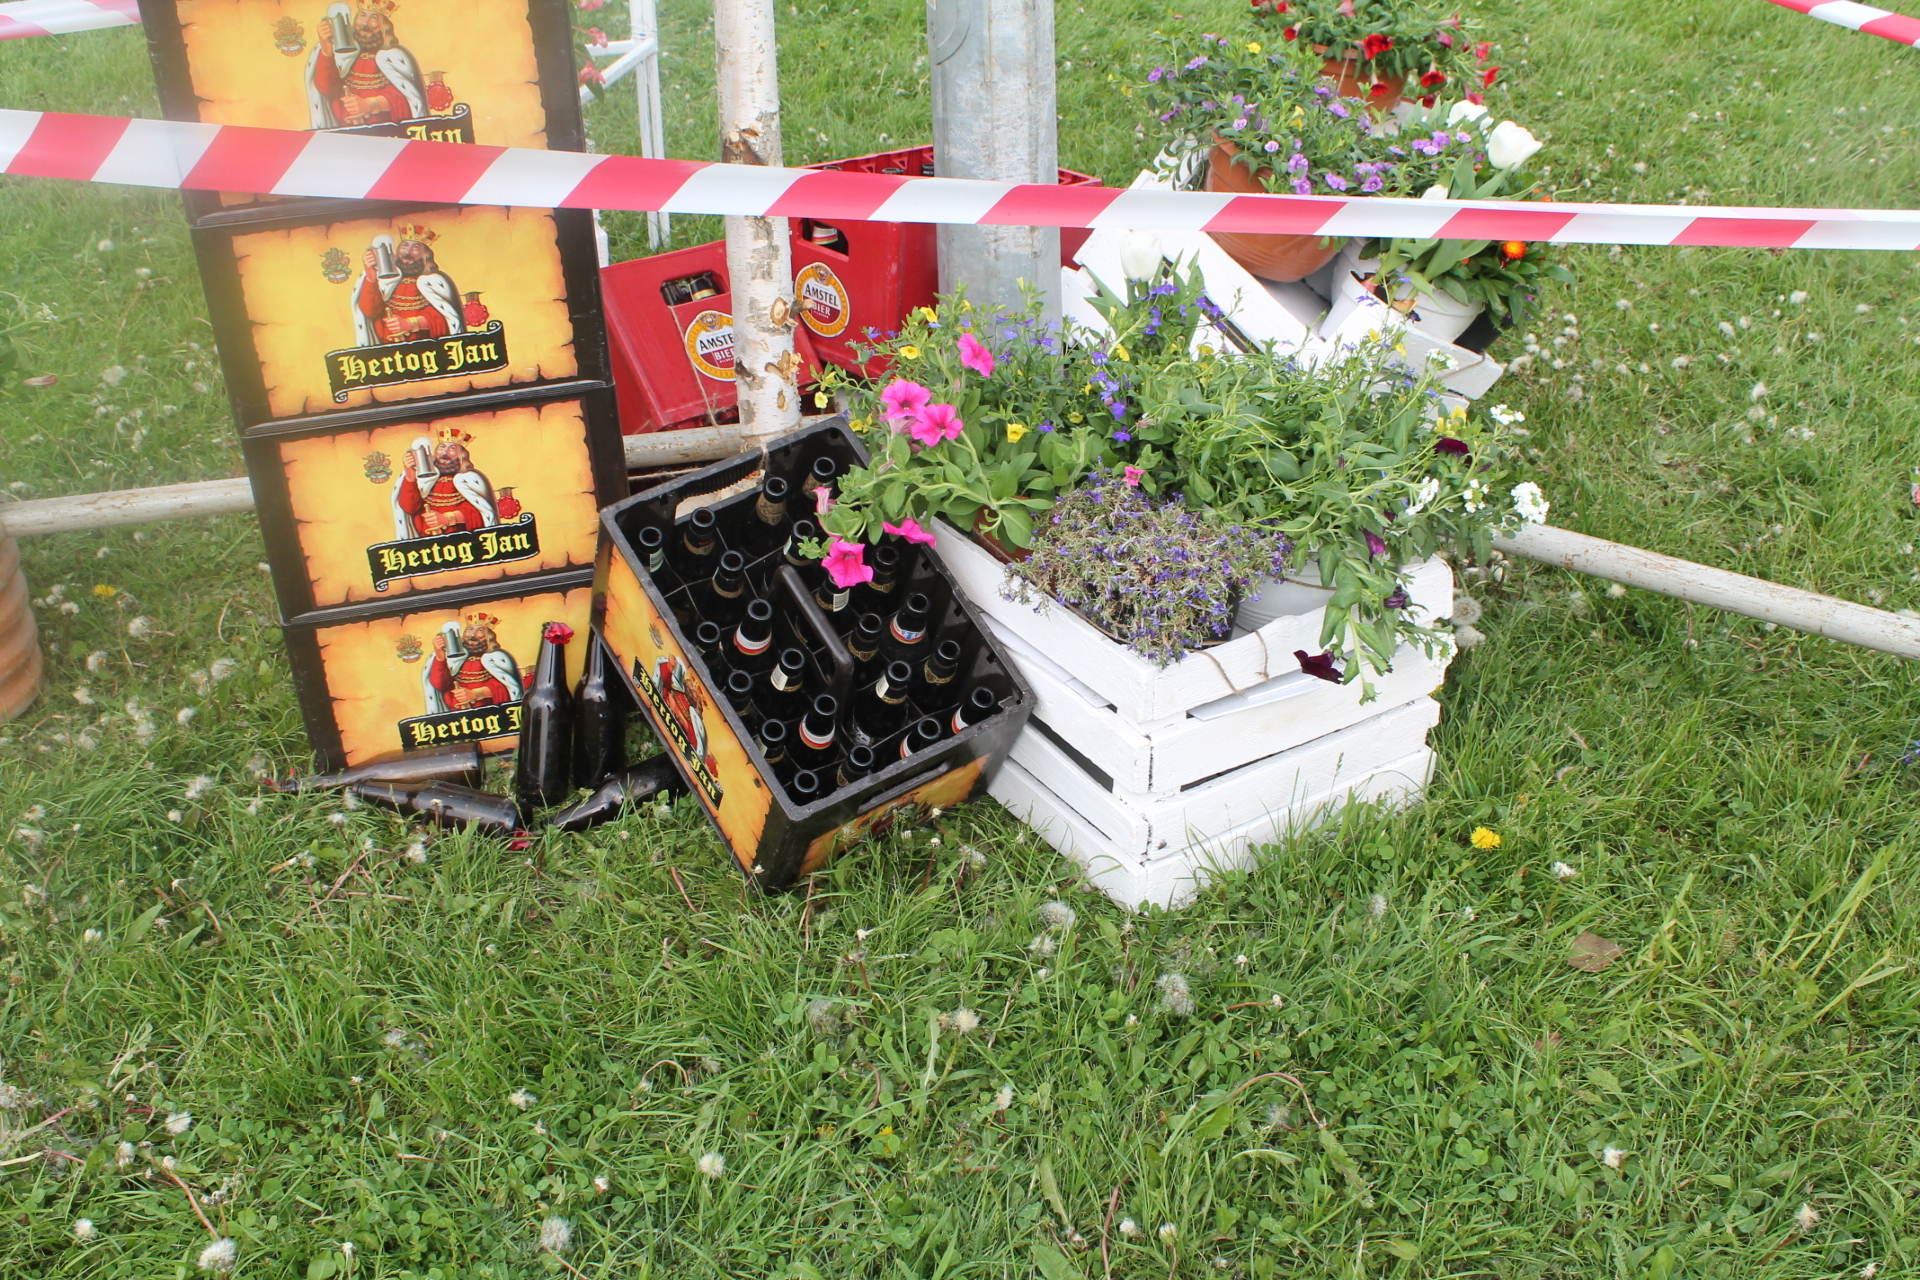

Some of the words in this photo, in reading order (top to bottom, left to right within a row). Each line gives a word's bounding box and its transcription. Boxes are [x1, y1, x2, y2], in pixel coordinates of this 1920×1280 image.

[805, 283, 838, 306] AMSTEL
[812, 302, 831, 316] BIER
[699, 332, 734, 351] AMSTE
[714, 347, 734, 361] BIE
[338, 350, 439, 384] Hertog
[444, 340, 499, 371] Jan
[378, 541, 474, 574] Hertog
[479, 532, 531, 561] Jan
[409, 714, 501, 746] Hertog
[639, 667, 688, 754] Hertog
[689, 750, 717, 801] Jan
